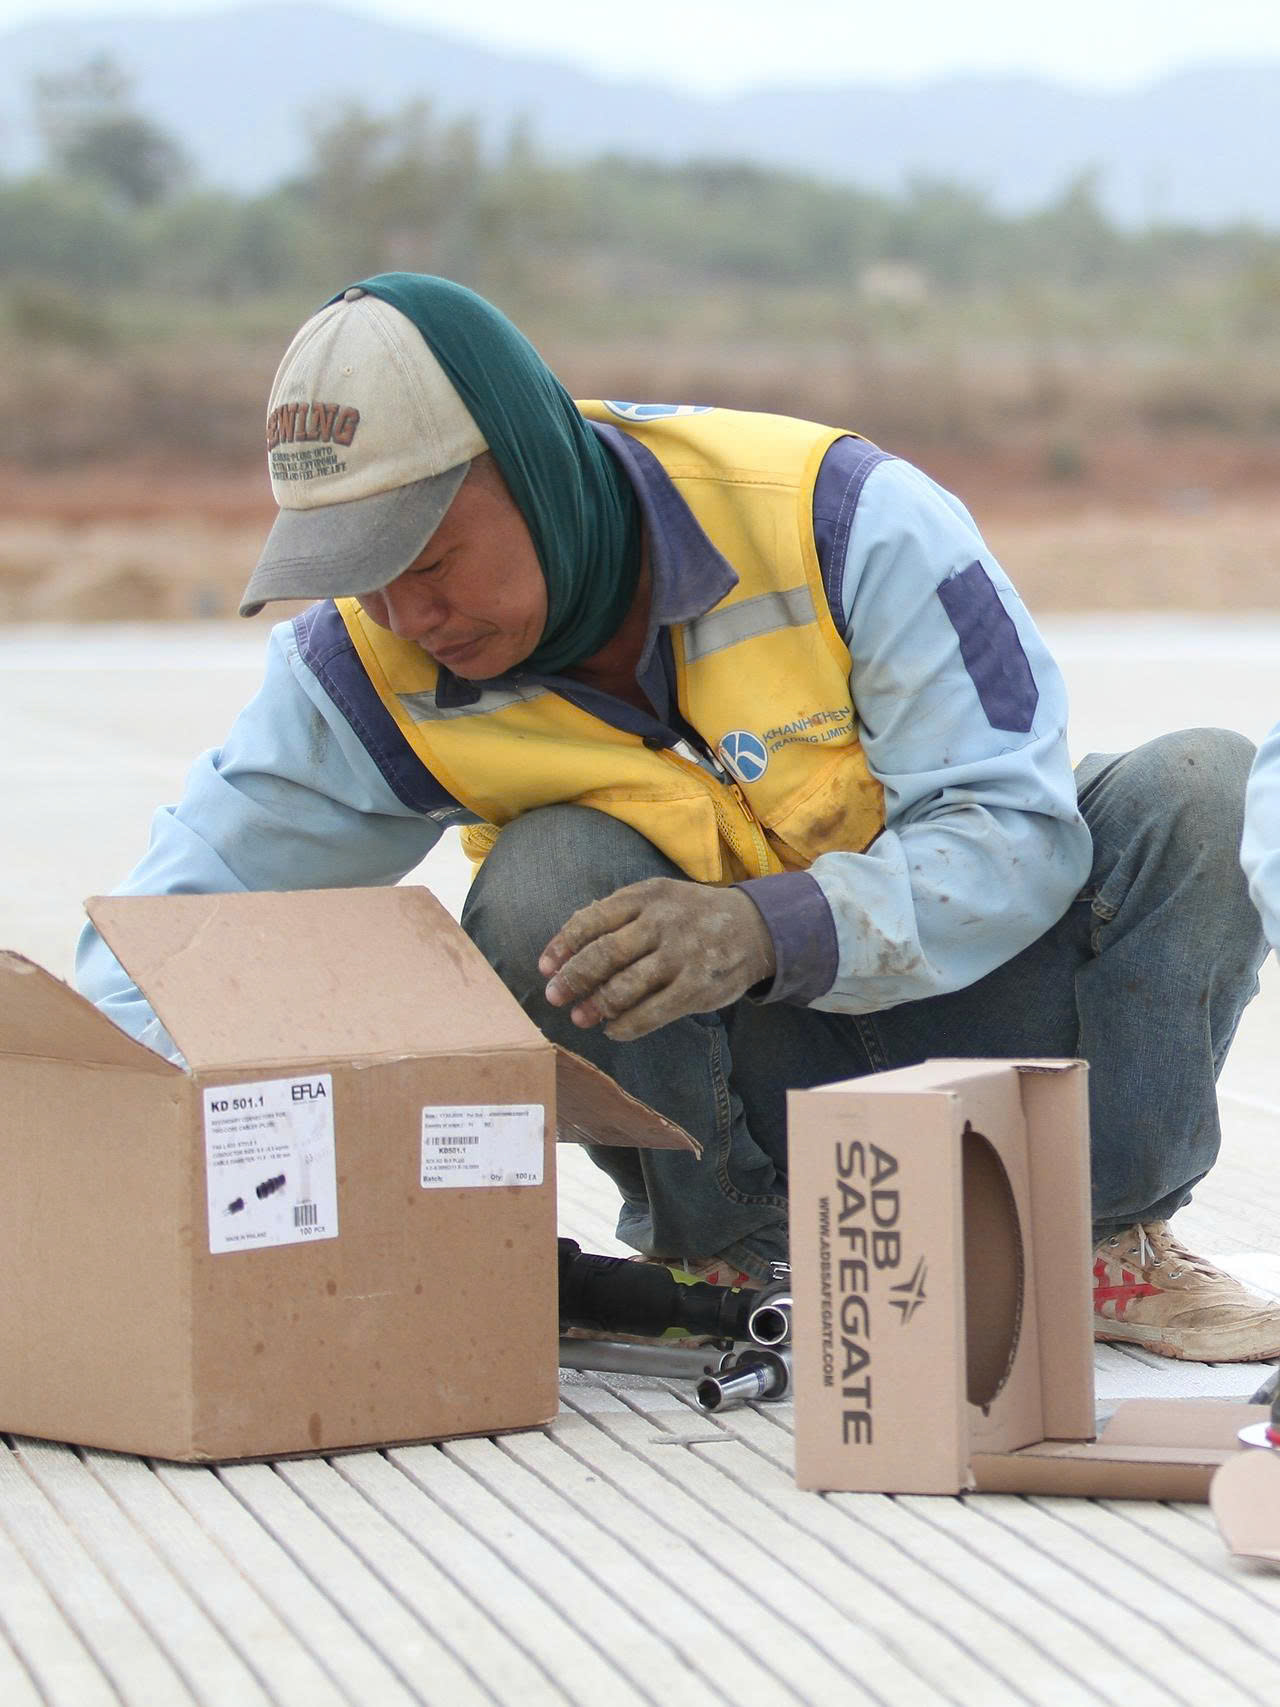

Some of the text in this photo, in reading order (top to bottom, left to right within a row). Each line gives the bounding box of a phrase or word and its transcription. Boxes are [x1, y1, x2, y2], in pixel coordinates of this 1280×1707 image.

[211, 1096, 265, 1113] KD 501.1
[291, 1082, 327, 1101] EFLA
[869, 1142, 901, 1270] ADB
[835, 1141, 873, 1445] SAFEGATE
